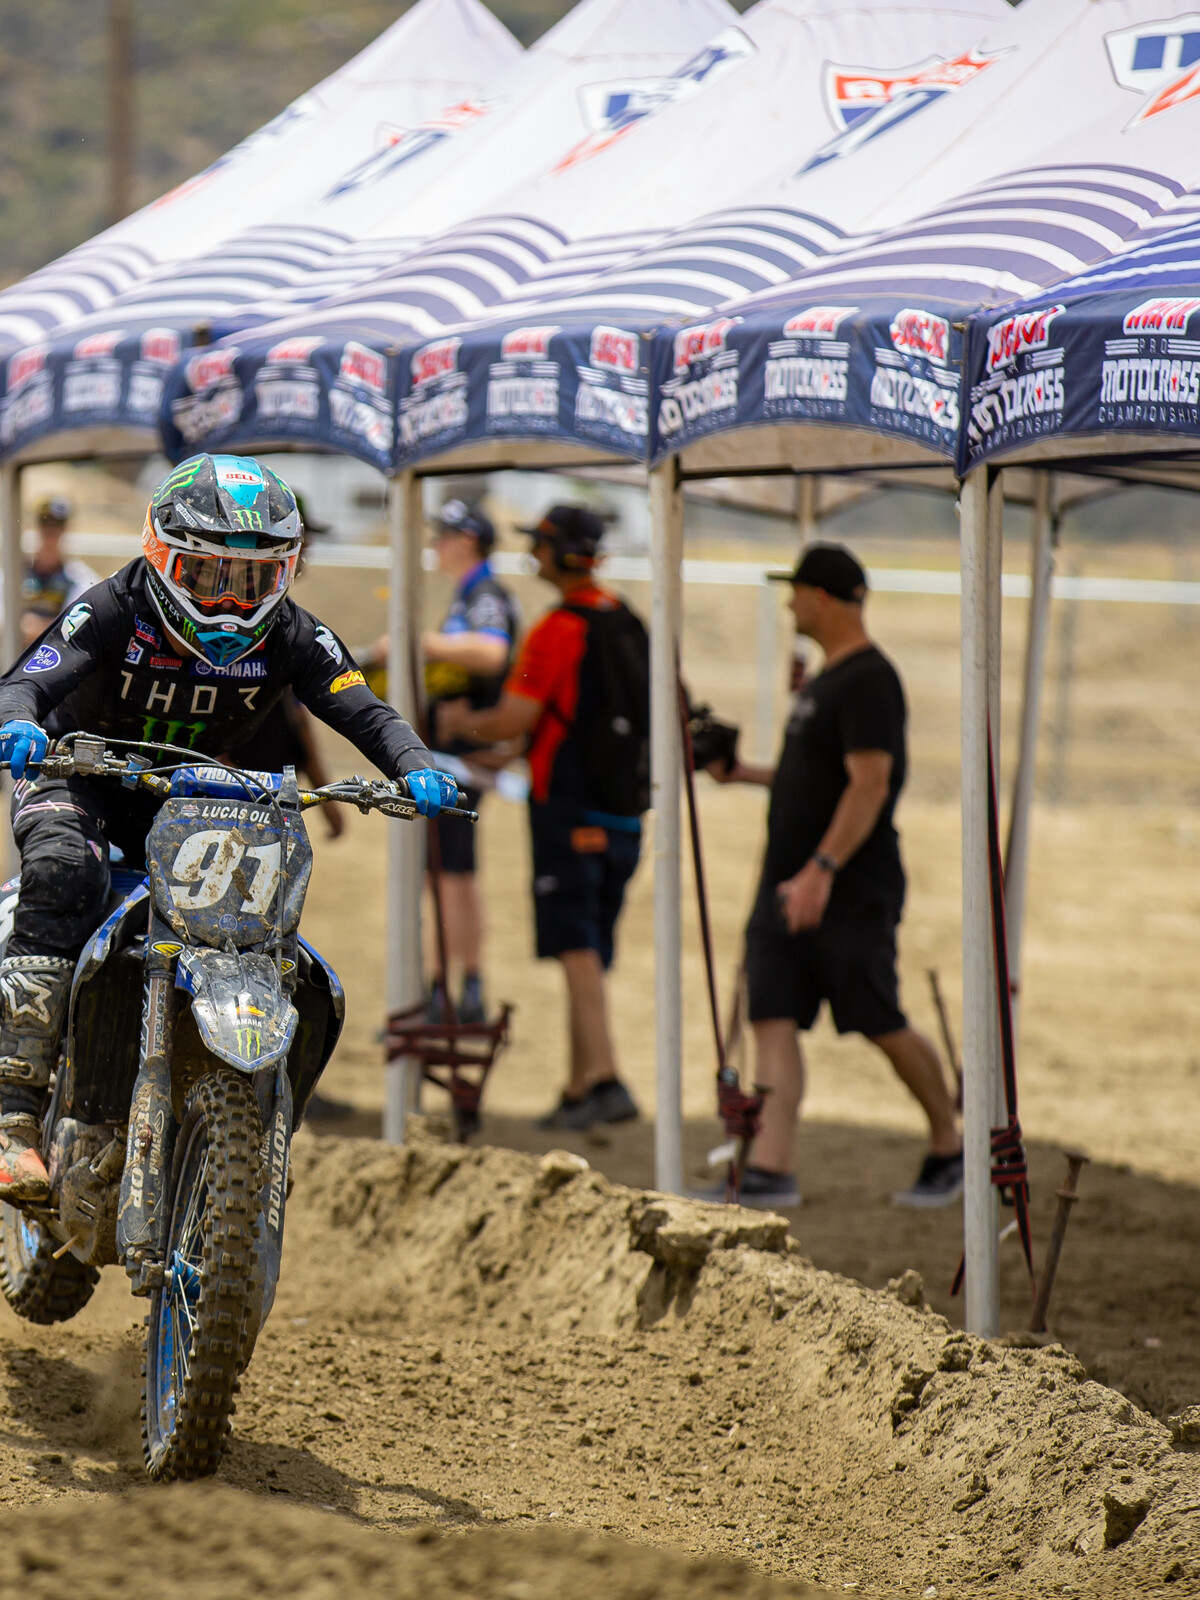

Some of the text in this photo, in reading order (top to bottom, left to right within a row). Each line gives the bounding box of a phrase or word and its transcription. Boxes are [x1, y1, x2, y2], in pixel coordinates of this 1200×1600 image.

[1139, 338, 1168, 354] PRO
[1100, 358, 1200, 404] MOTOCROSS
[1098, 405, 1199, 424] CHAMPIONSHIP
[225, 473, 256, 482] BELL
[201, 805, 247, 820] LUCAS
[249, 810, 271, 824] OIL
[380, 803, 416, 816] ARC
[169, 829, 296, 916] 91
[231, 1018, 262, 1028] YAMAHA
[267, 1110, 287, 1232] DUNLOP
